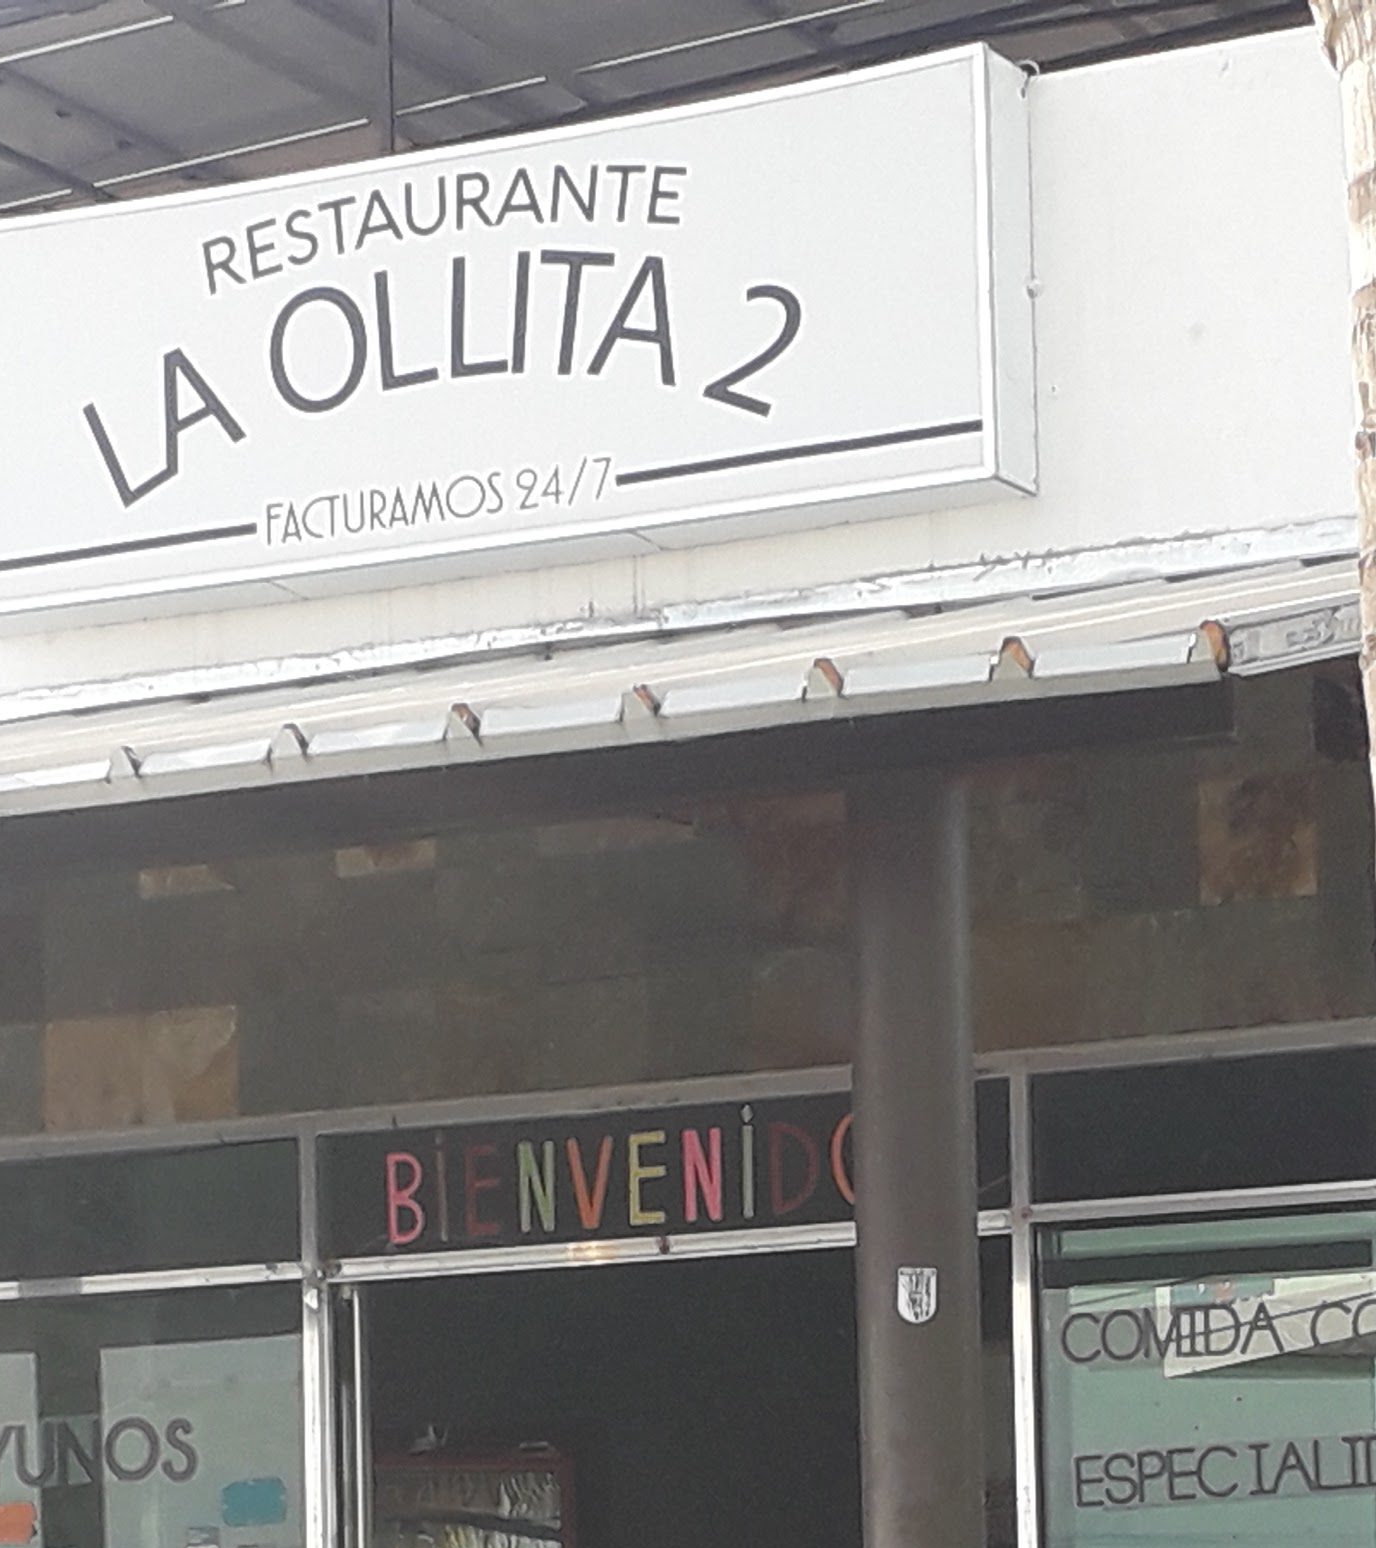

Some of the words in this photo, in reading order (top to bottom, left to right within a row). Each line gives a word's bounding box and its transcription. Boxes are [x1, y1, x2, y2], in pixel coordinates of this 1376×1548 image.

[202, 164, 687, 295] RESTAURANTE
[82, 347, 248, 508] LA
[269, 248, 678, 413] OLLITA
[702, 285, 802, 418] 2
[266, 471, 504, 546] FACTURAMOS
[516, 456, 612, 510] 24/7
[1061, 1302, 1285, 1364] COMIDA
